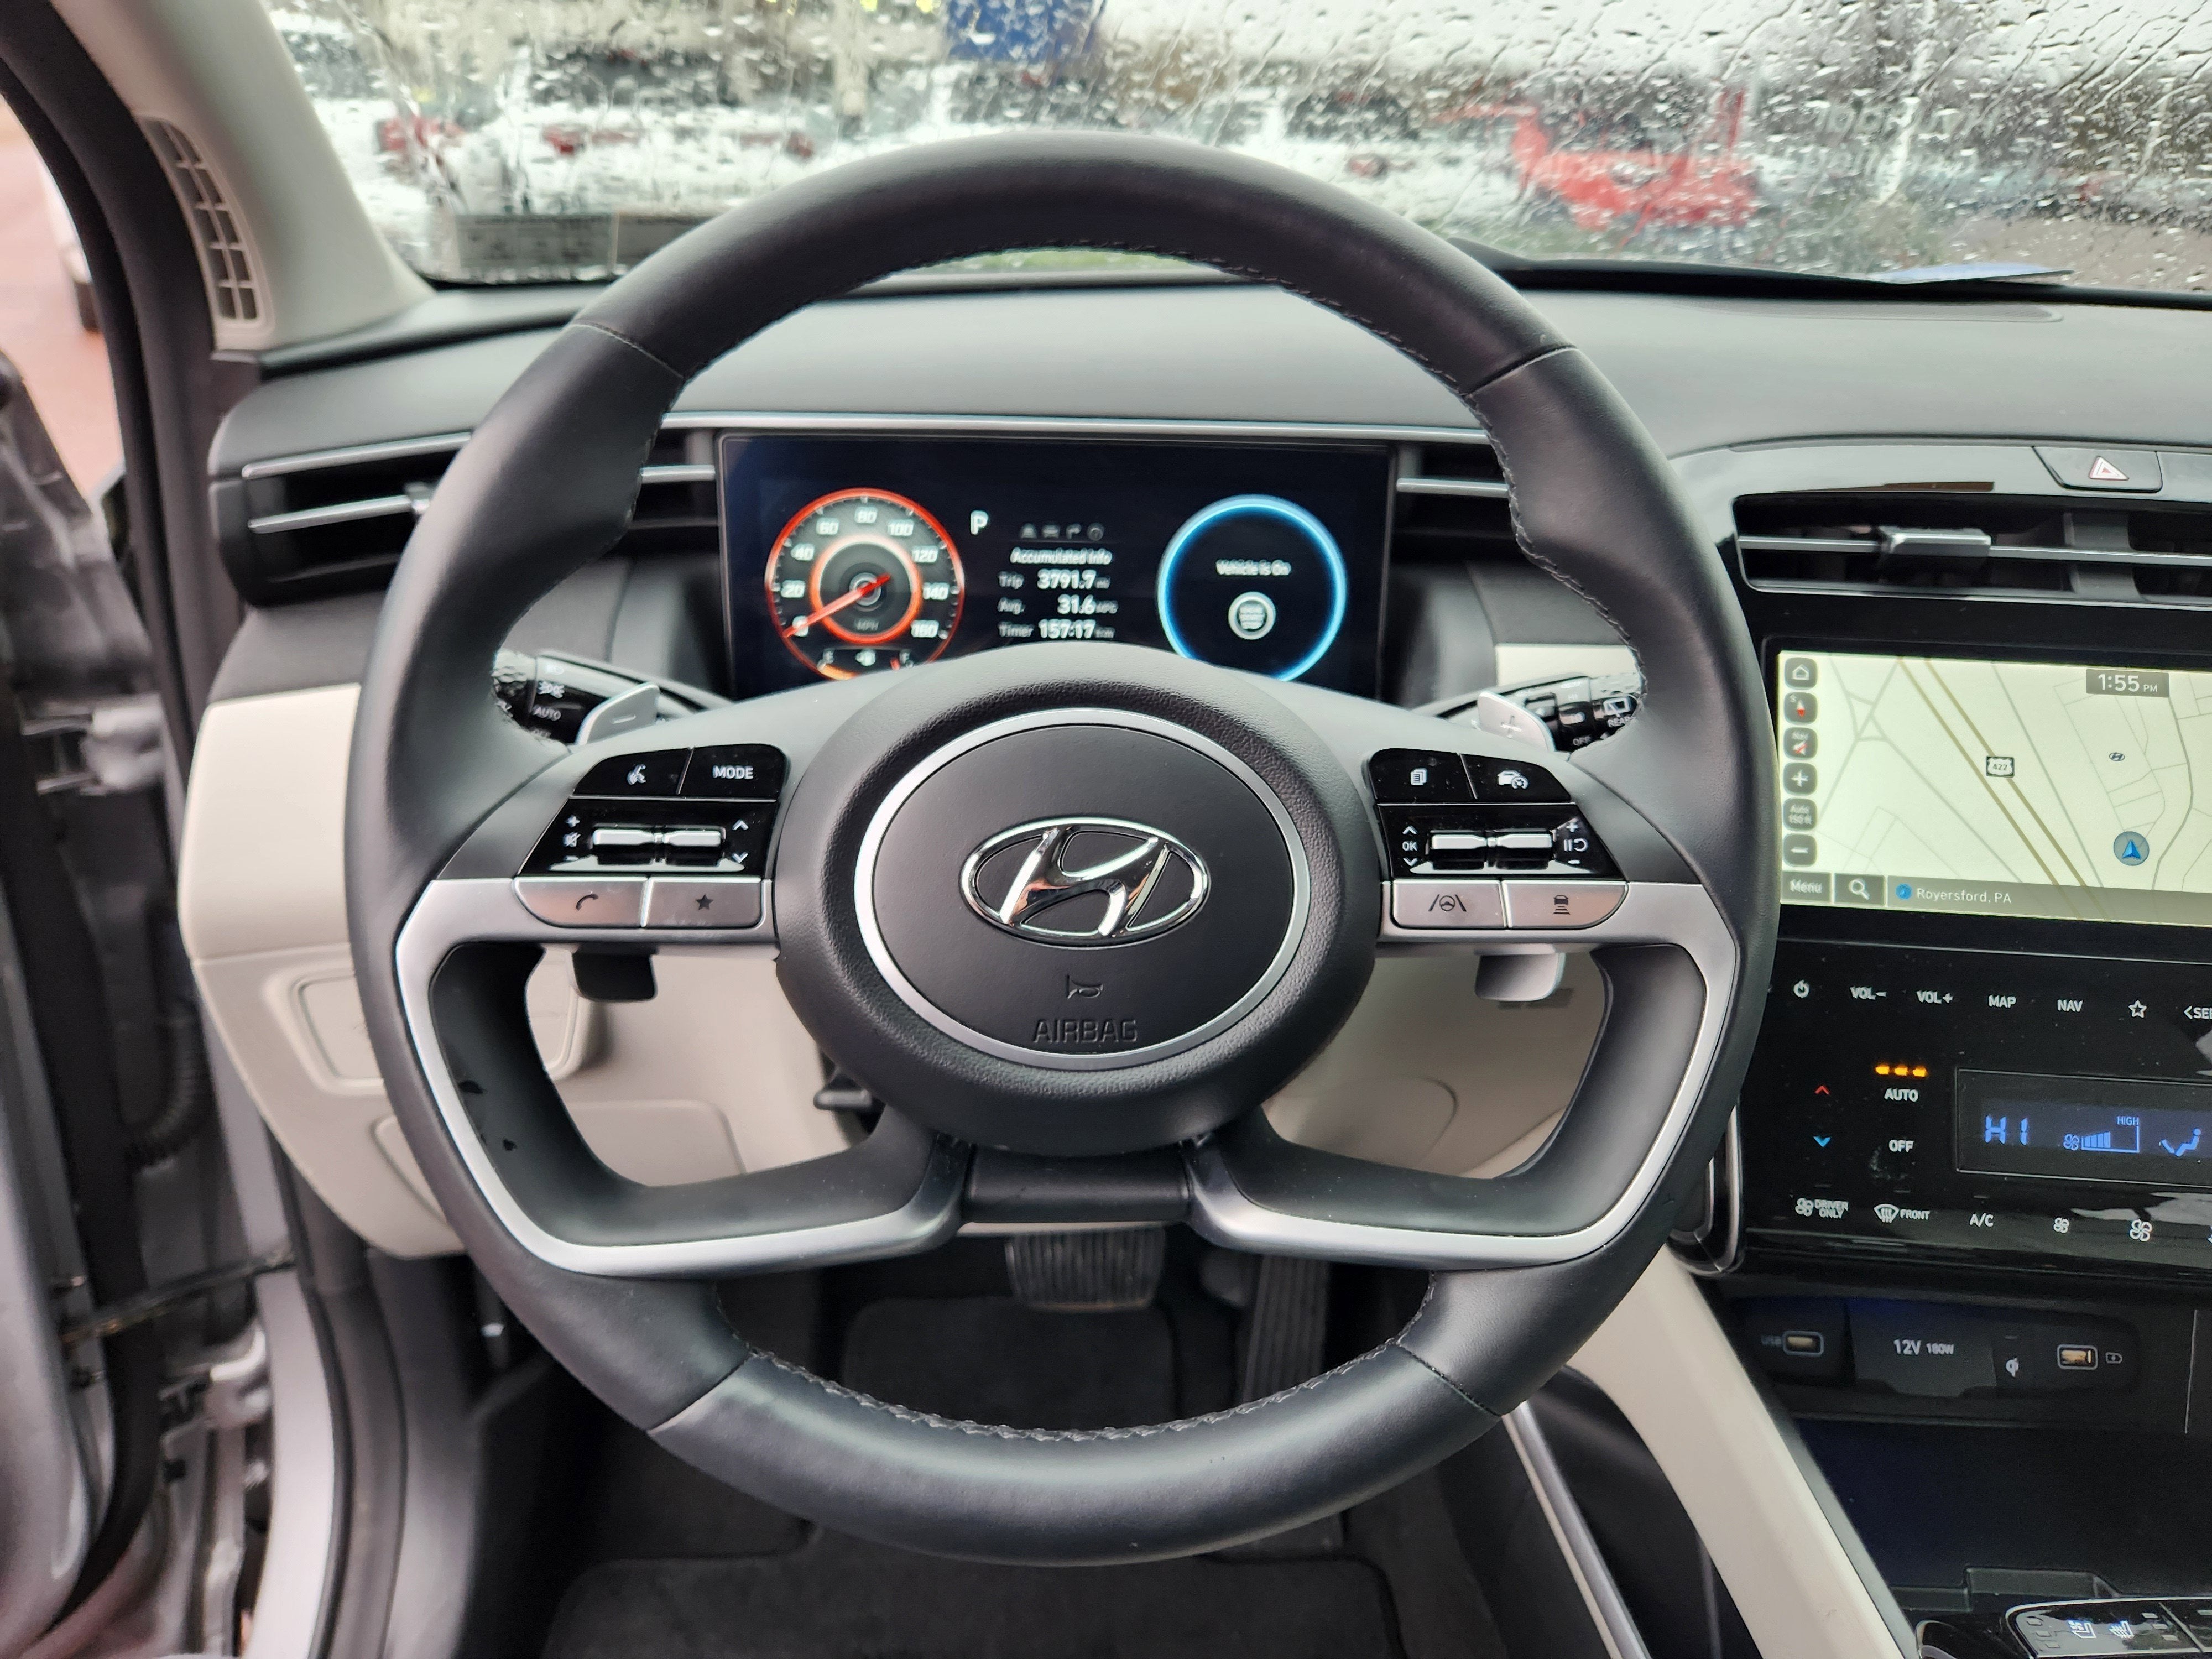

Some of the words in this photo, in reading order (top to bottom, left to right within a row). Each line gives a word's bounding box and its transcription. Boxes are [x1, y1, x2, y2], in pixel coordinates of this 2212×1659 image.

[816, 518, 838, 535] 60
[888, 519, 914, 536] 100
[970, 510, 989, 535] P
[791, 543, 815, 561] 40
[912, 545, 938, 563] 120
[1010, 547, 1087, 564] Accumulated
[1088, 547, 1113, 565] Info
[998, 571, 1024, 589] Trip
[1037, 569, 1096, 589] 3791.7
[781, 580, 805, 598] 20
[922, 582, 949, 600] 140
[1057, 594, 1096, 614] 31.6
[911, 620, 939, 638] 160
[998, 622, 1034, 637] Timer
[1038, 619, 1096, 638] 157:17
[2098, 674, 2140, 692] 1:55
[2143, 684, 2157, 692] PM
[533, 705, 562, 721] AUTO
[713, 766, 754, 779] MODE
[1402, 841, 1417, 851] OK
[1790, 879, 1822, 893] Menu
[1917, 888, 1991, 903] Royersford,
[1994, 892, 2011, 904] PA
[1988, 995, 2016, 1008] MAP
[2057, 999, 2083, 1013] NAV
[1033, 1018, 1138, 1044] AIRBAG
[1884, 1088, 1919, 1102] AUTO
[2116, 1115, 2139, 1126] HIGH
[1888, 1139, 1914, 1152] OFF
[1814, 1199, 1849, 1211] DRIVER
[1818, 1208, 1844, 1219] ONLY
[1900, 1209, 1930, 1220] FRONT
[1969, 1213, 1994, 1227] A/C
[1893, 1339, 1921, 1355] 12V
